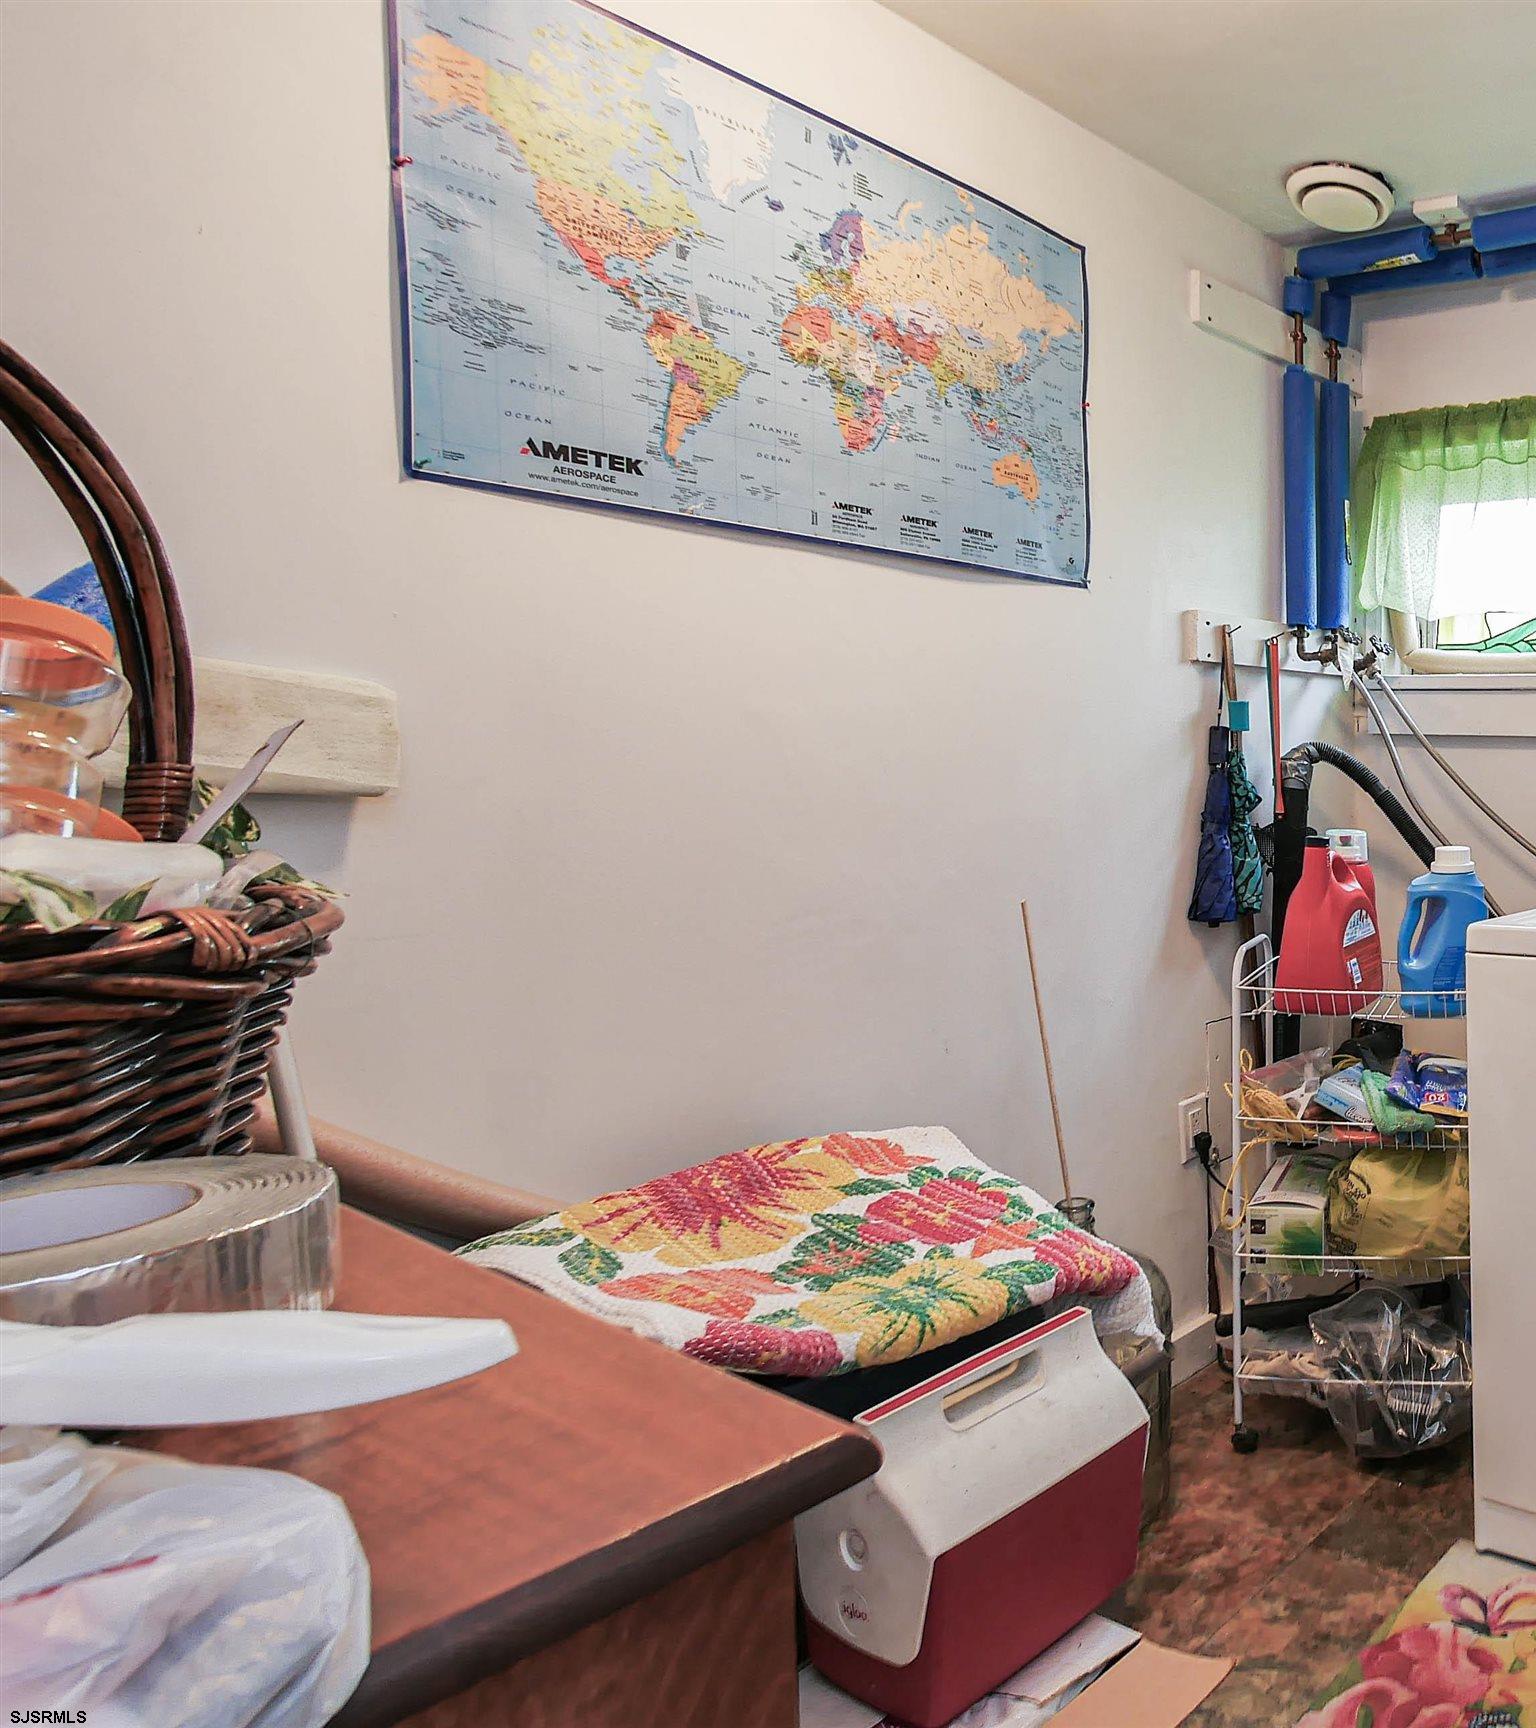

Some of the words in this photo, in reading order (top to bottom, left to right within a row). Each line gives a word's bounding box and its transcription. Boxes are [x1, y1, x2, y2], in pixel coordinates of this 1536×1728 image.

[707, 273, 757, 293] ATLANTIC
[715, 305, 751, 320] OCEAN
[509, 378, 566, 396] PACIFIC
[504, 410, 553, 425] OCEAN
[749, 422, 799, 438] ATLANTIC
[519, 437, 644, 476] AMETEK
[756, 452, 792, 464] OCEAN
[553, 466, 616, 484] AEROSPACE
[528, 471, 639, 498] www.ametek.com/aerospace
[832, 501, 873, 516] AMETEK
[900, 515, 938, 528] AMETEK
[962, 527, 993, 539] AMETEK
[1016, 539, 1043, 550] AMETEK
